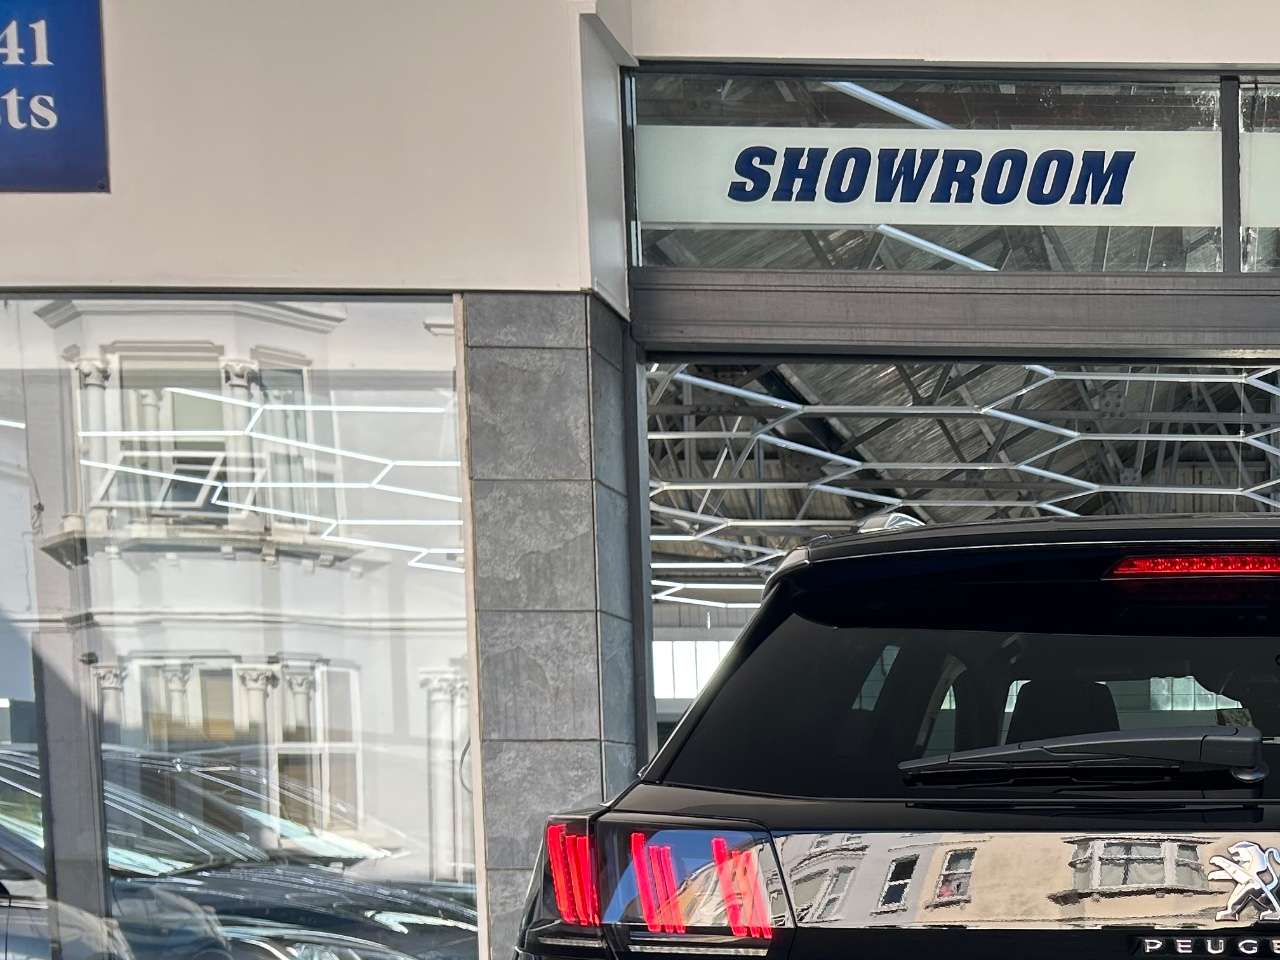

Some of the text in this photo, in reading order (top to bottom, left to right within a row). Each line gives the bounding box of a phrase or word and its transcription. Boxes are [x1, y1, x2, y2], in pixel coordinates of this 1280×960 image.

[0, 19, 54, 65] 41
[0, 87, 58, 130] ts
[727, 145, 1136, 206] SHOWROOM
